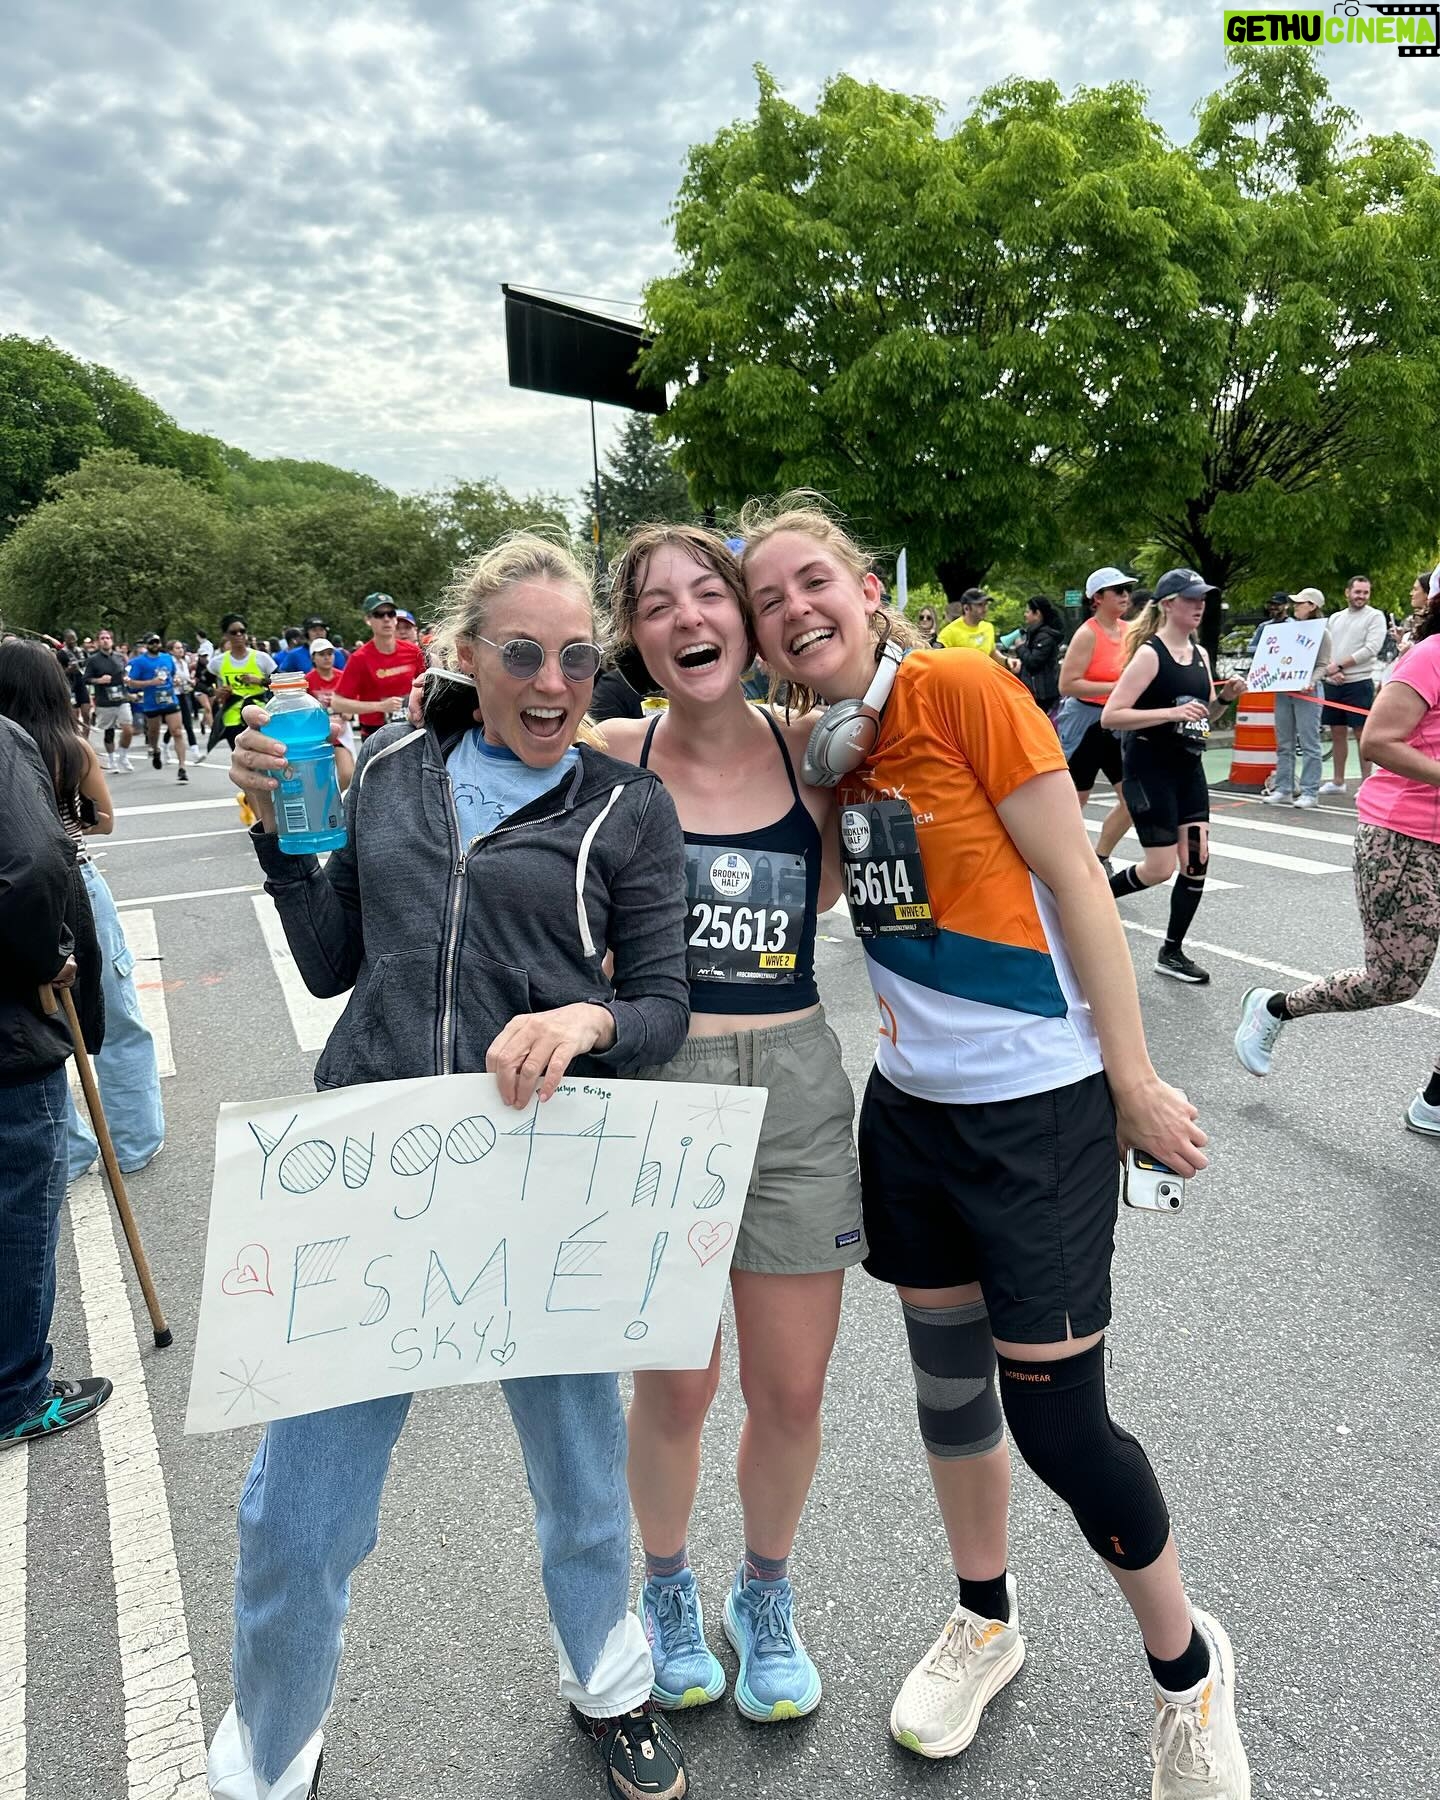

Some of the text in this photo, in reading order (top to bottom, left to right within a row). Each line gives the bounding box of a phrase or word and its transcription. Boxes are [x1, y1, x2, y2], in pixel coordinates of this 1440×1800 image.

[712, 868, 750, 880] BROOKLYN
[721, 878, 740, 888] HALF
[901, 907, 925, 918] WAVE 2
[689, 903, 789, 953] 25613
[765, 955, 790, 967] WAVE 2
[583, 1085, 612, 1099] Bridge
